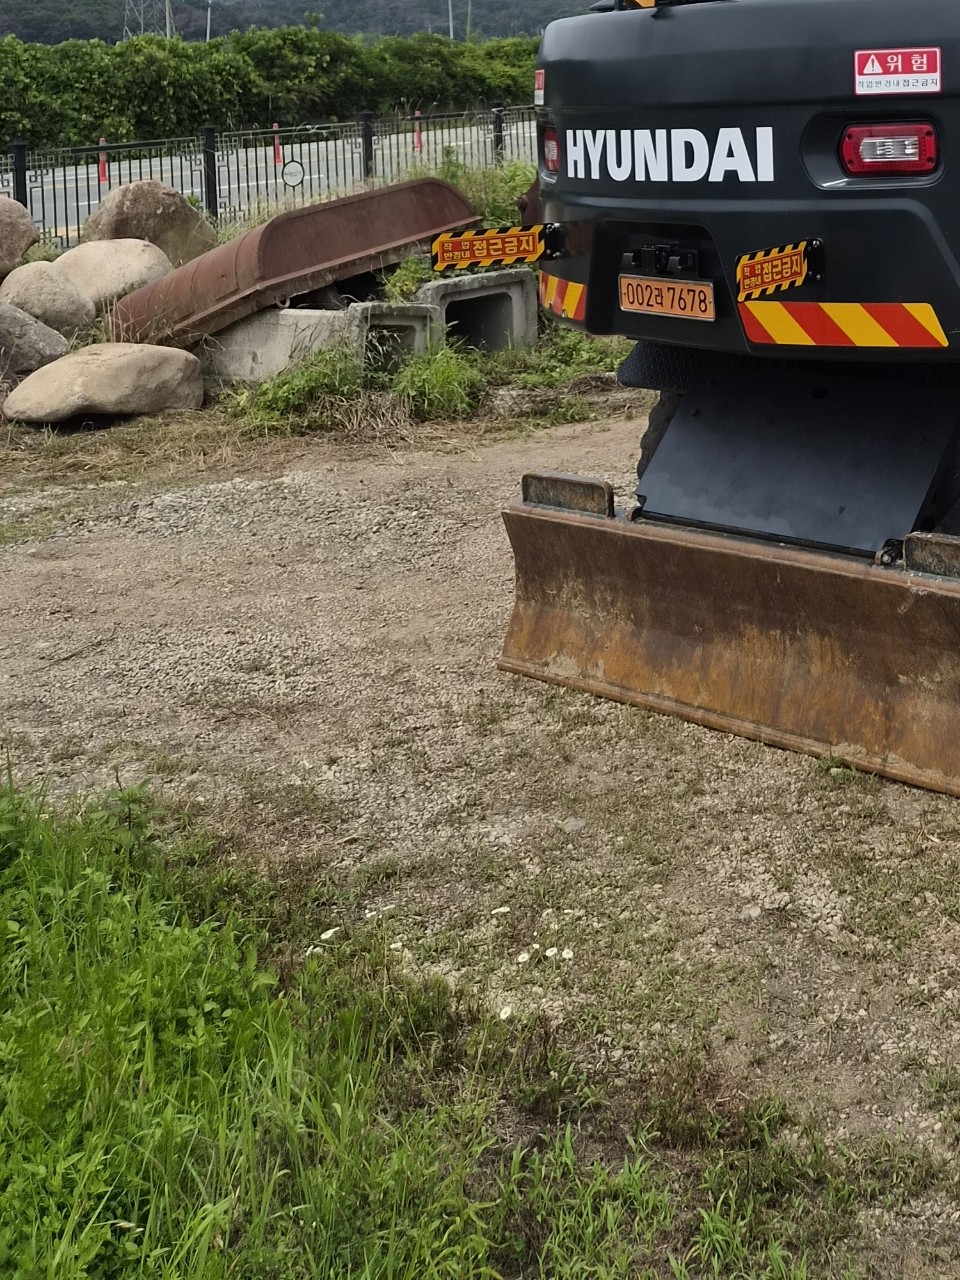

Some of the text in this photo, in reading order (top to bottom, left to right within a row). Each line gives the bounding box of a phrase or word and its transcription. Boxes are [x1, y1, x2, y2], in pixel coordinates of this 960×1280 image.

[565, 126, 775, 182] HYUNDAI
[472, 235, 534, 257] 접근금지
[762, 254, 801, 283] 접근금지
[667, 287, 708, 313] 7678
